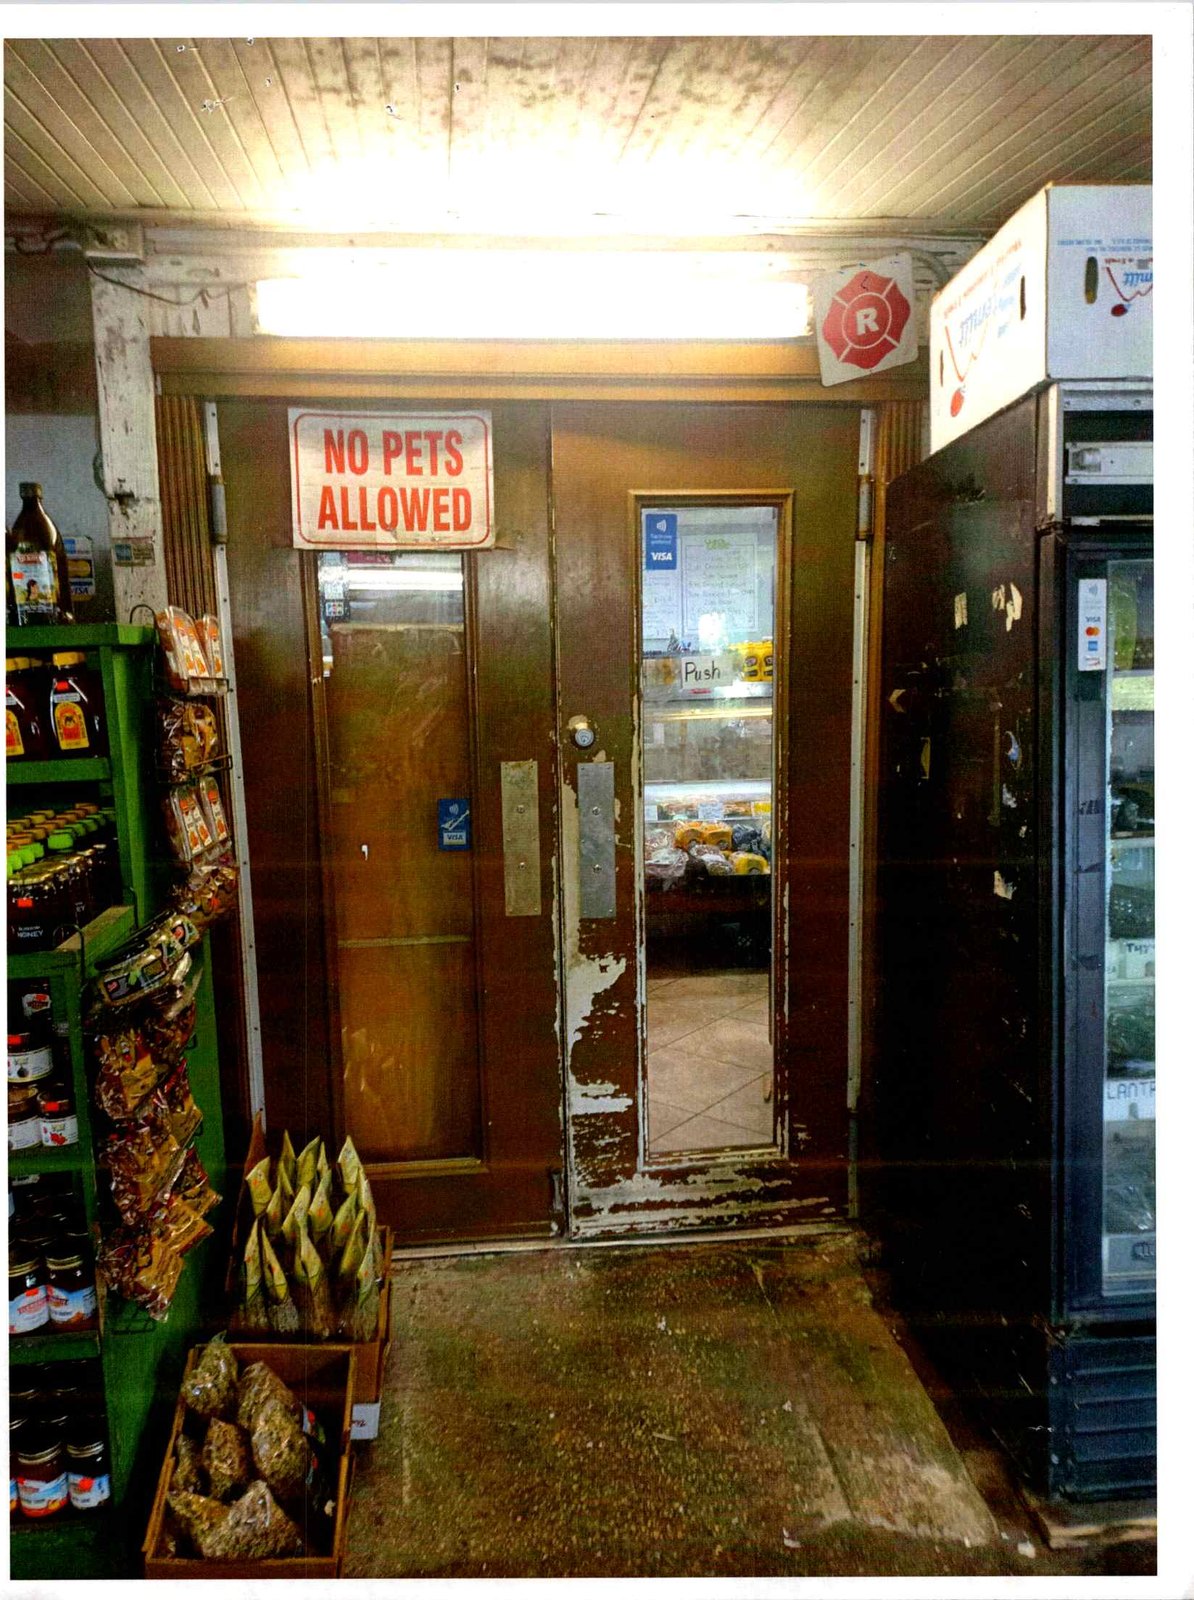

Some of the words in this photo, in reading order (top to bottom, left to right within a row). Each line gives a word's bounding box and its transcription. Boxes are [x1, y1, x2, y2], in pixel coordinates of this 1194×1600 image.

[856, 307, 880, 335] R
[323, 429, 369, 476] NO
[382, 429, 464, 477] PETS
[318, 485, 472, 532] ALLOWED
[650, 552, 673, 561] VISA
[684, 660, 721, 682] Push
[17, 929, 44, 938] HONEY
